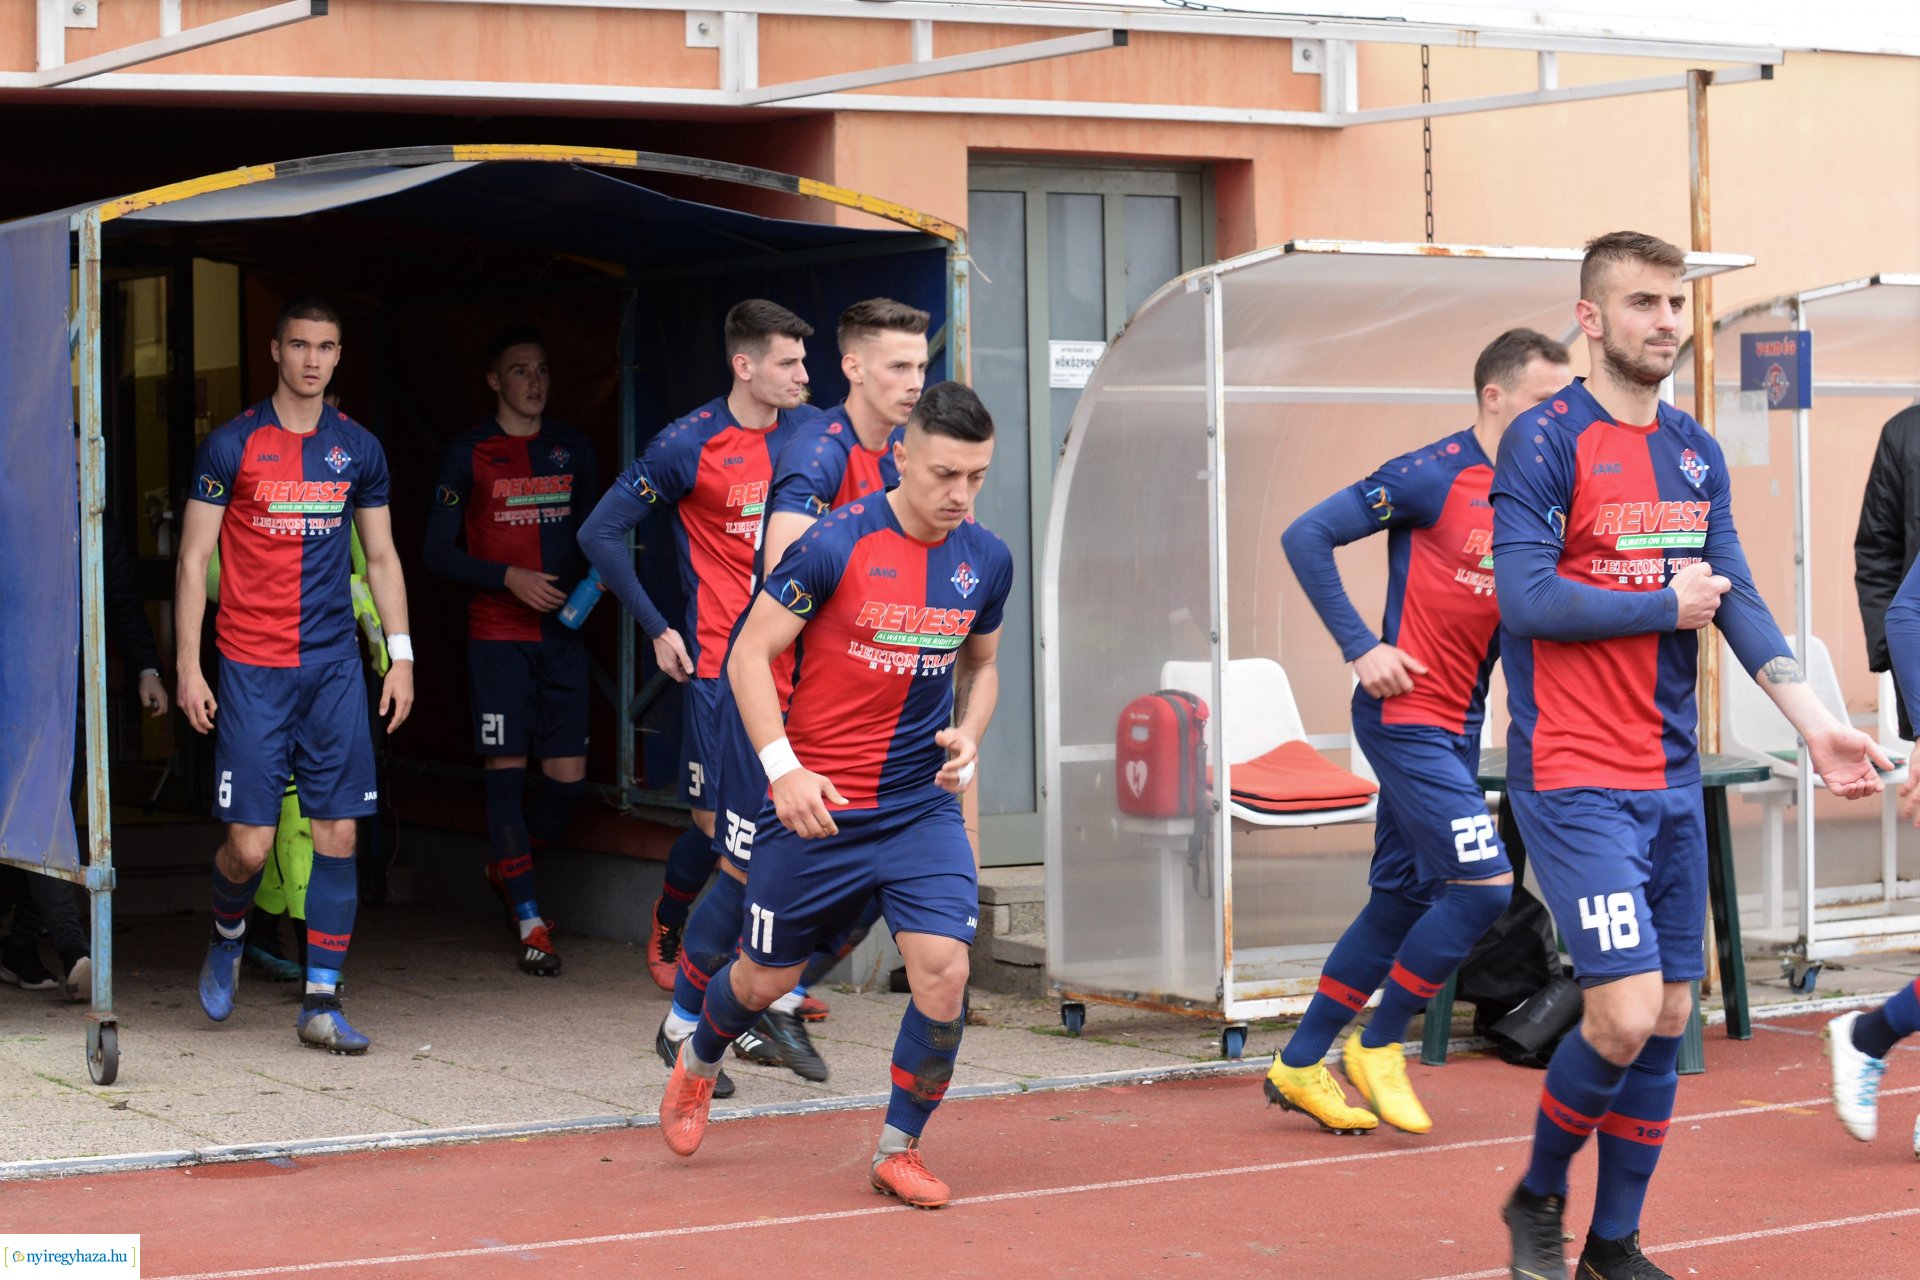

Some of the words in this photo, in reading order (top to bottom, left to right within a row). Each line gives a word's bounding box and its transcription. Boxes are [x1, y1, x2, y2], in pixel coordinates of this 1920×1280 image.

[256, 453, 279, 463] JAKO
[723, 456, 744, 466] JAKO
[1592, 462, 1622, 475] JAKO
[254, 480, 351, 502] REVESZ
[253, 515, 307, 530] LERTON
[1592, 500, 1711, 535] REVESZ
[1647, 537, 1660, 545] ON
[868, 566, 897, 579] JAKO
[1590, 558, 1666, 576] LERTON
[855, 601, 977, 636] REVESZ
[876, 633, 907, 642] ALWAYS
[907, 635, 918, 643] ON
[919, 636, 932, 644] THE
[932, 638, 951, 646] RIGHT
[847, 640, 920, 668] LERTON
[481, 713, 505, 745] 21
[218, 770, 233, 808] 6
[725, 808, 758, 861] 32
[1451, 814, 1499, 864] 22
[750, 902, 775, 954] 11
[1578, 892, 1640, 951] 48
